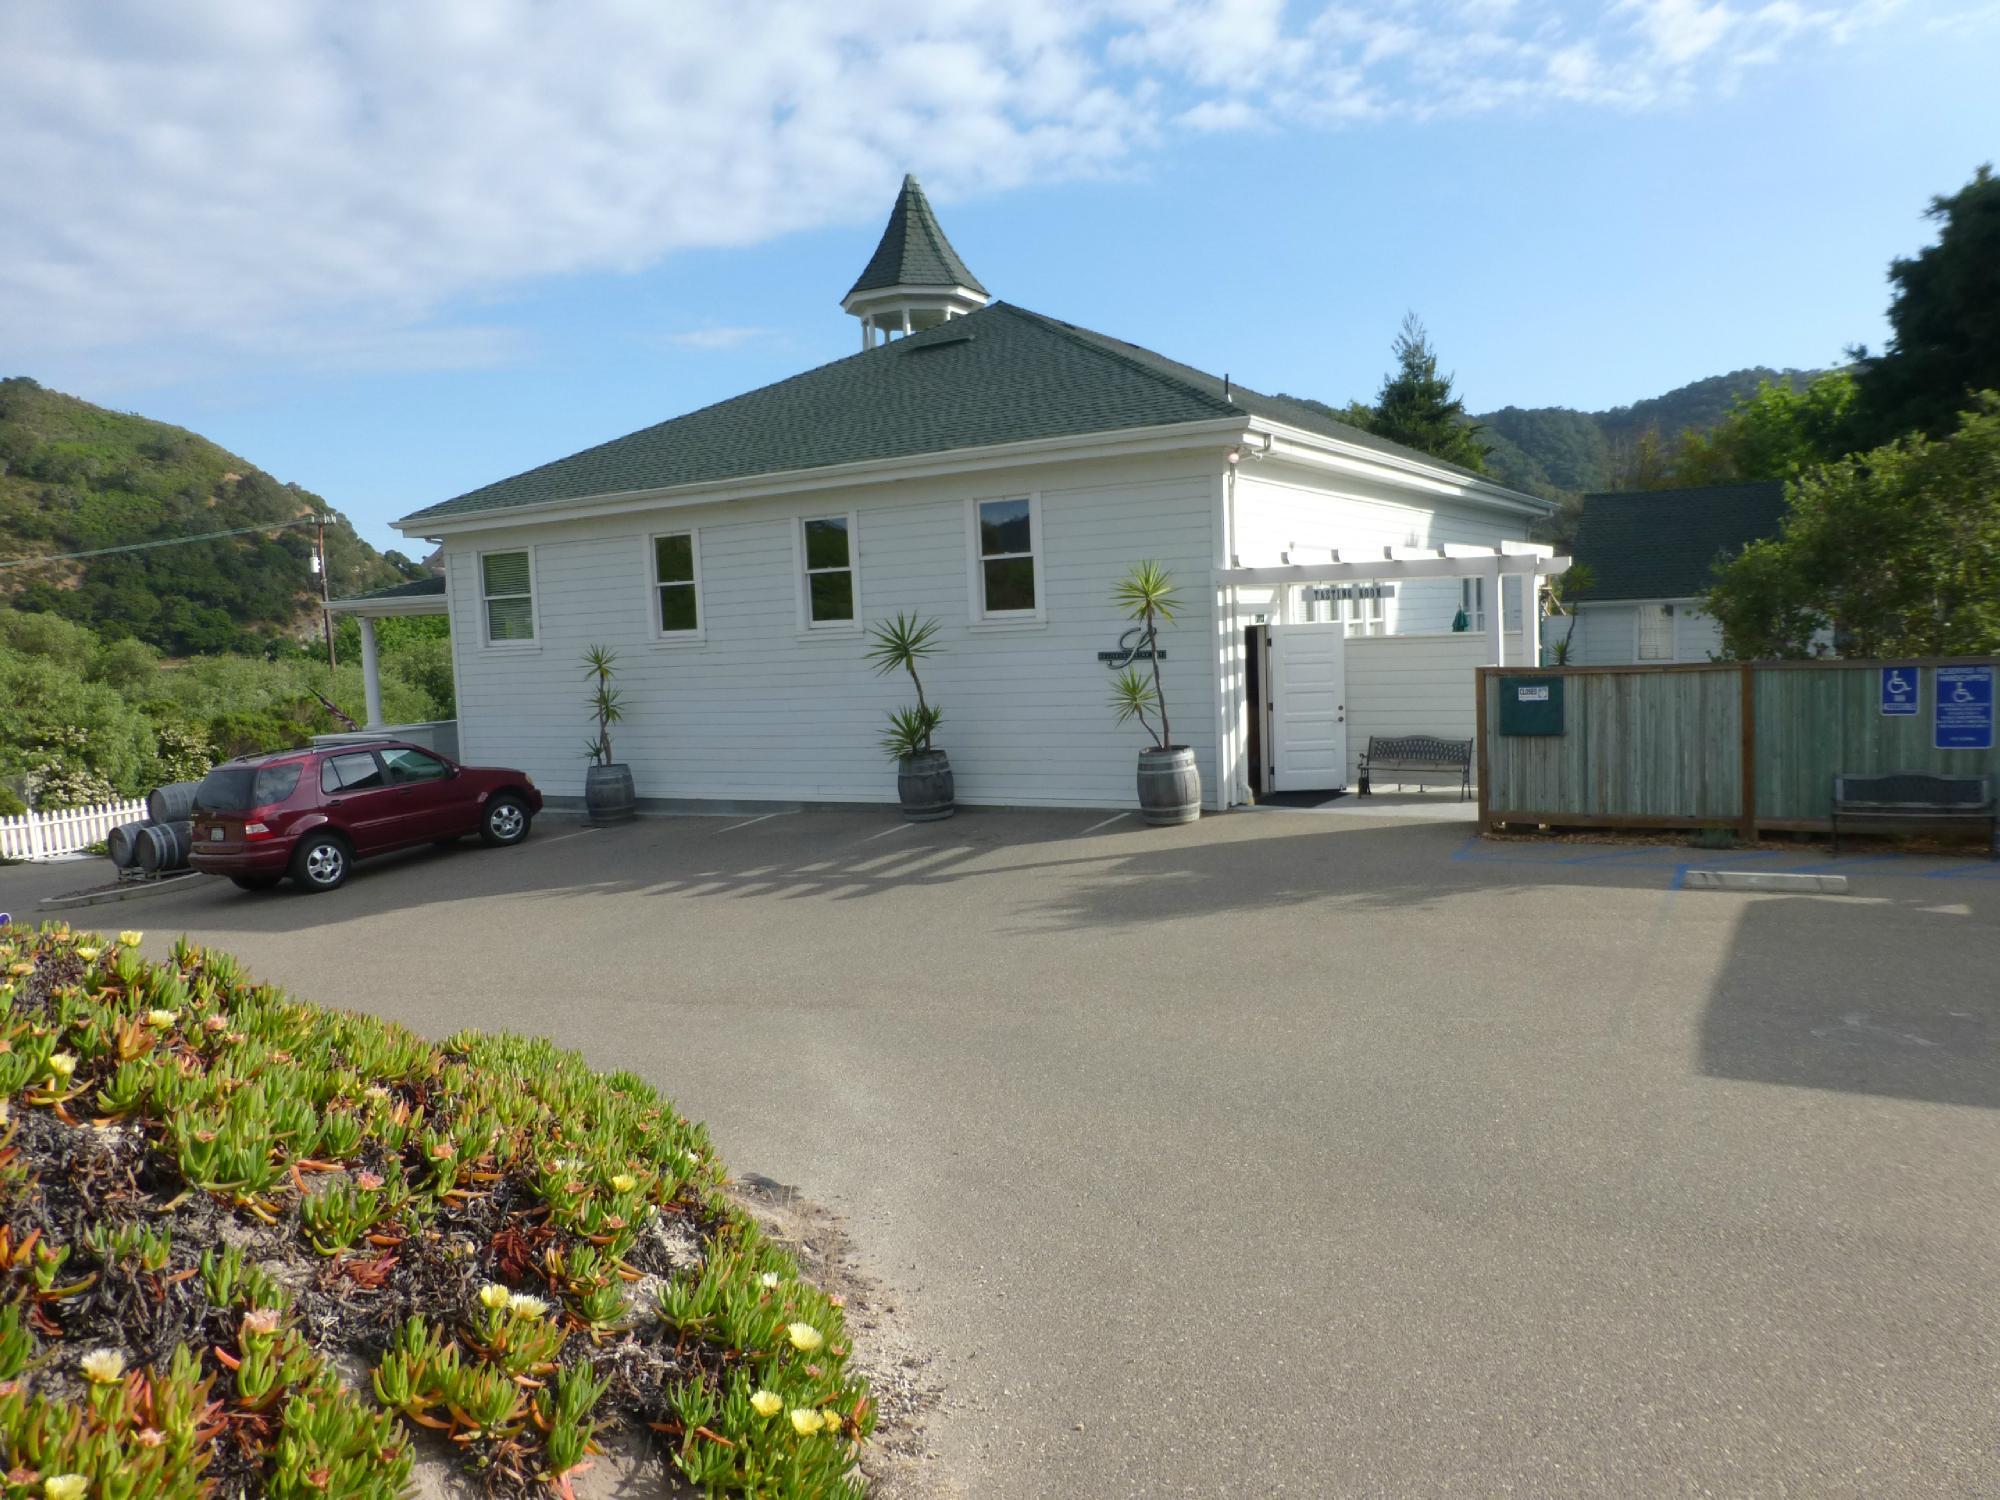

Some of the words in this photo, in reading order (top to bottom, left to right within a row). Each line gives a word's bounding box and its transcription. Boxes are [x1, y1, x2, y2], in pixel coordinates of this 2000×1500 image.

[1313, 589, 1352, 600] TASTING
[1359, 587, 1381, 599] ROOM
[1519, 688, 1537, 696] CLOSED
